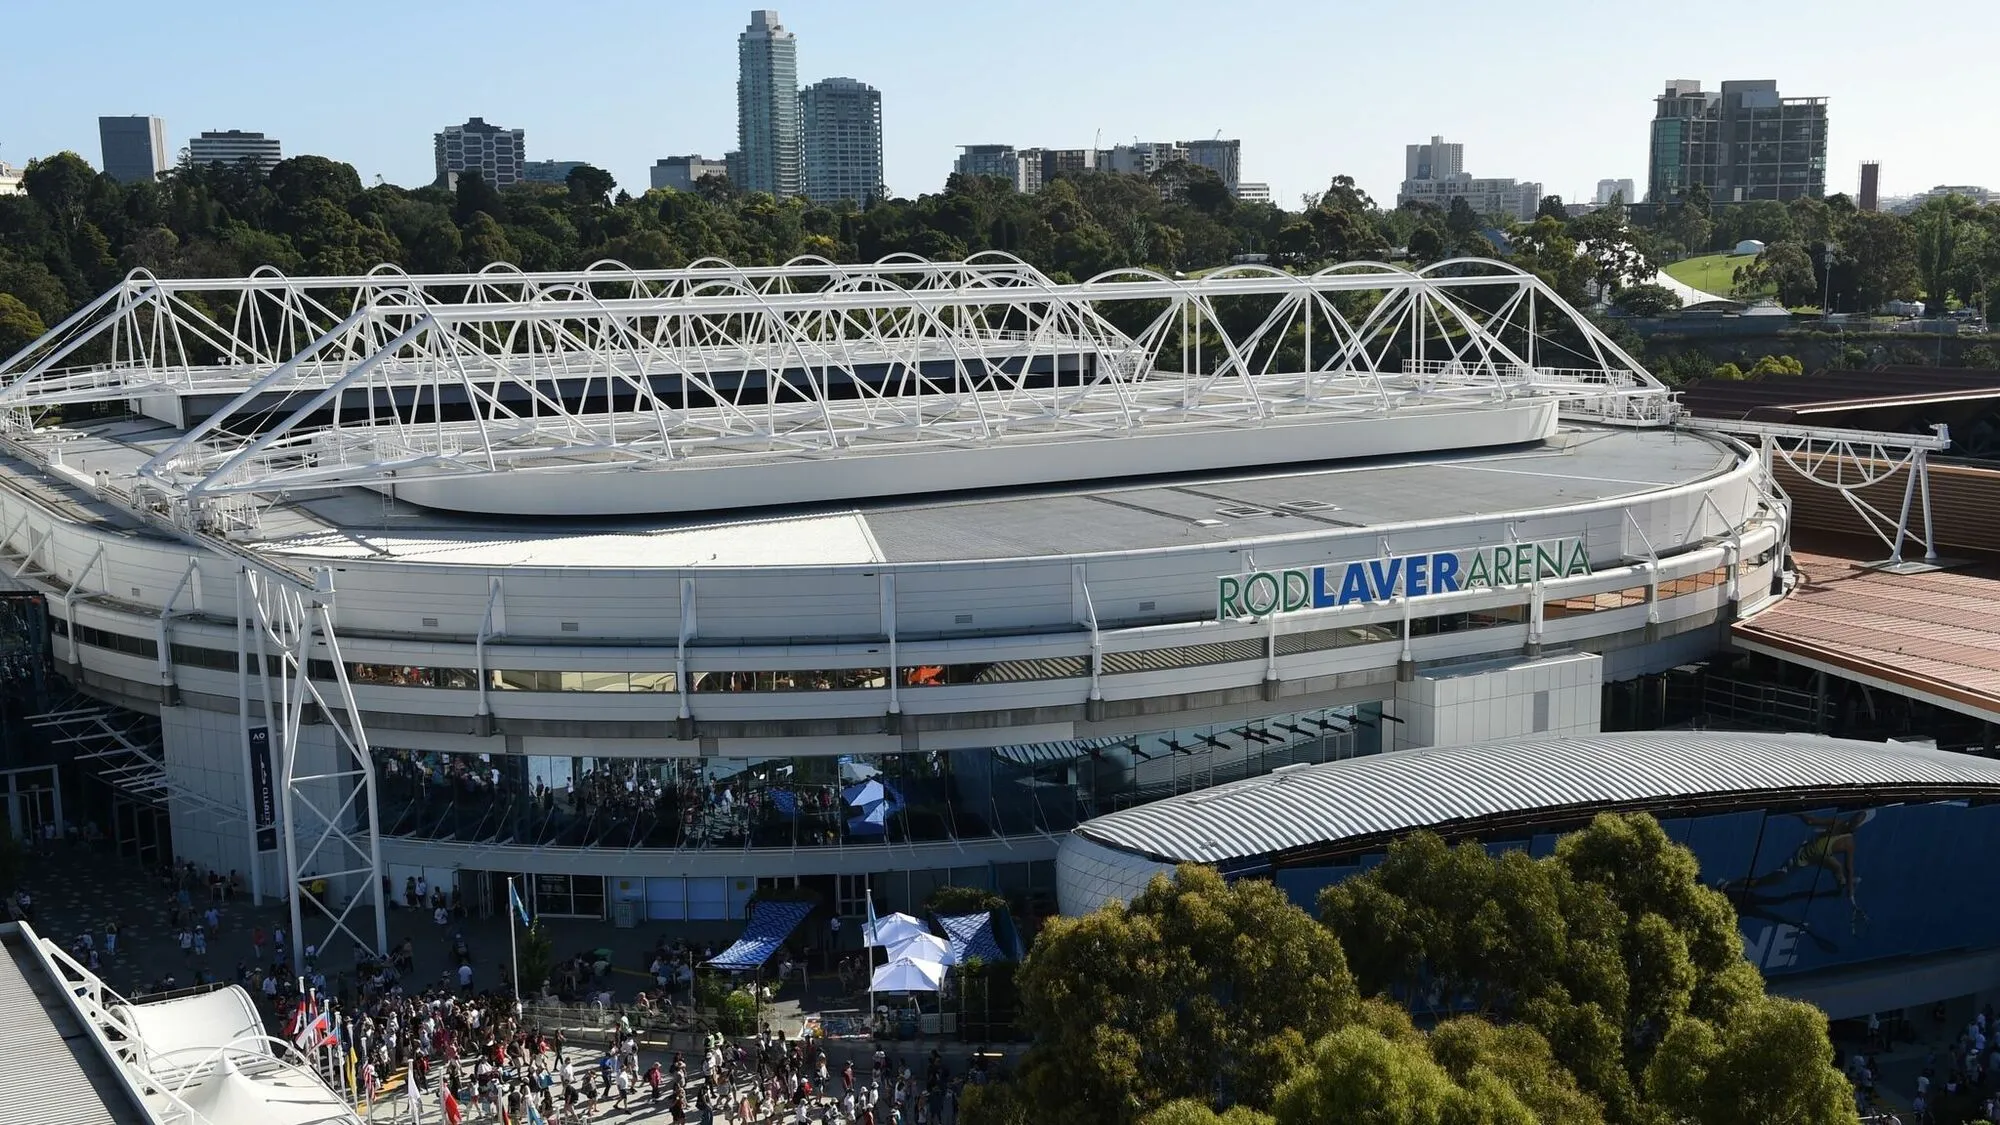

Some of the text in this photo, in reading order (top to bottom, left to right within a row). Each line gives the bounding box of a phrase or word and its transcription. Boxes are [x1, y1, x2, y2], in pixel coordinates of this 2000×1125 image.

[1220, 536, 1593, 620] ROD LAVER ARENA
[252, 732, 266, 740] AO
